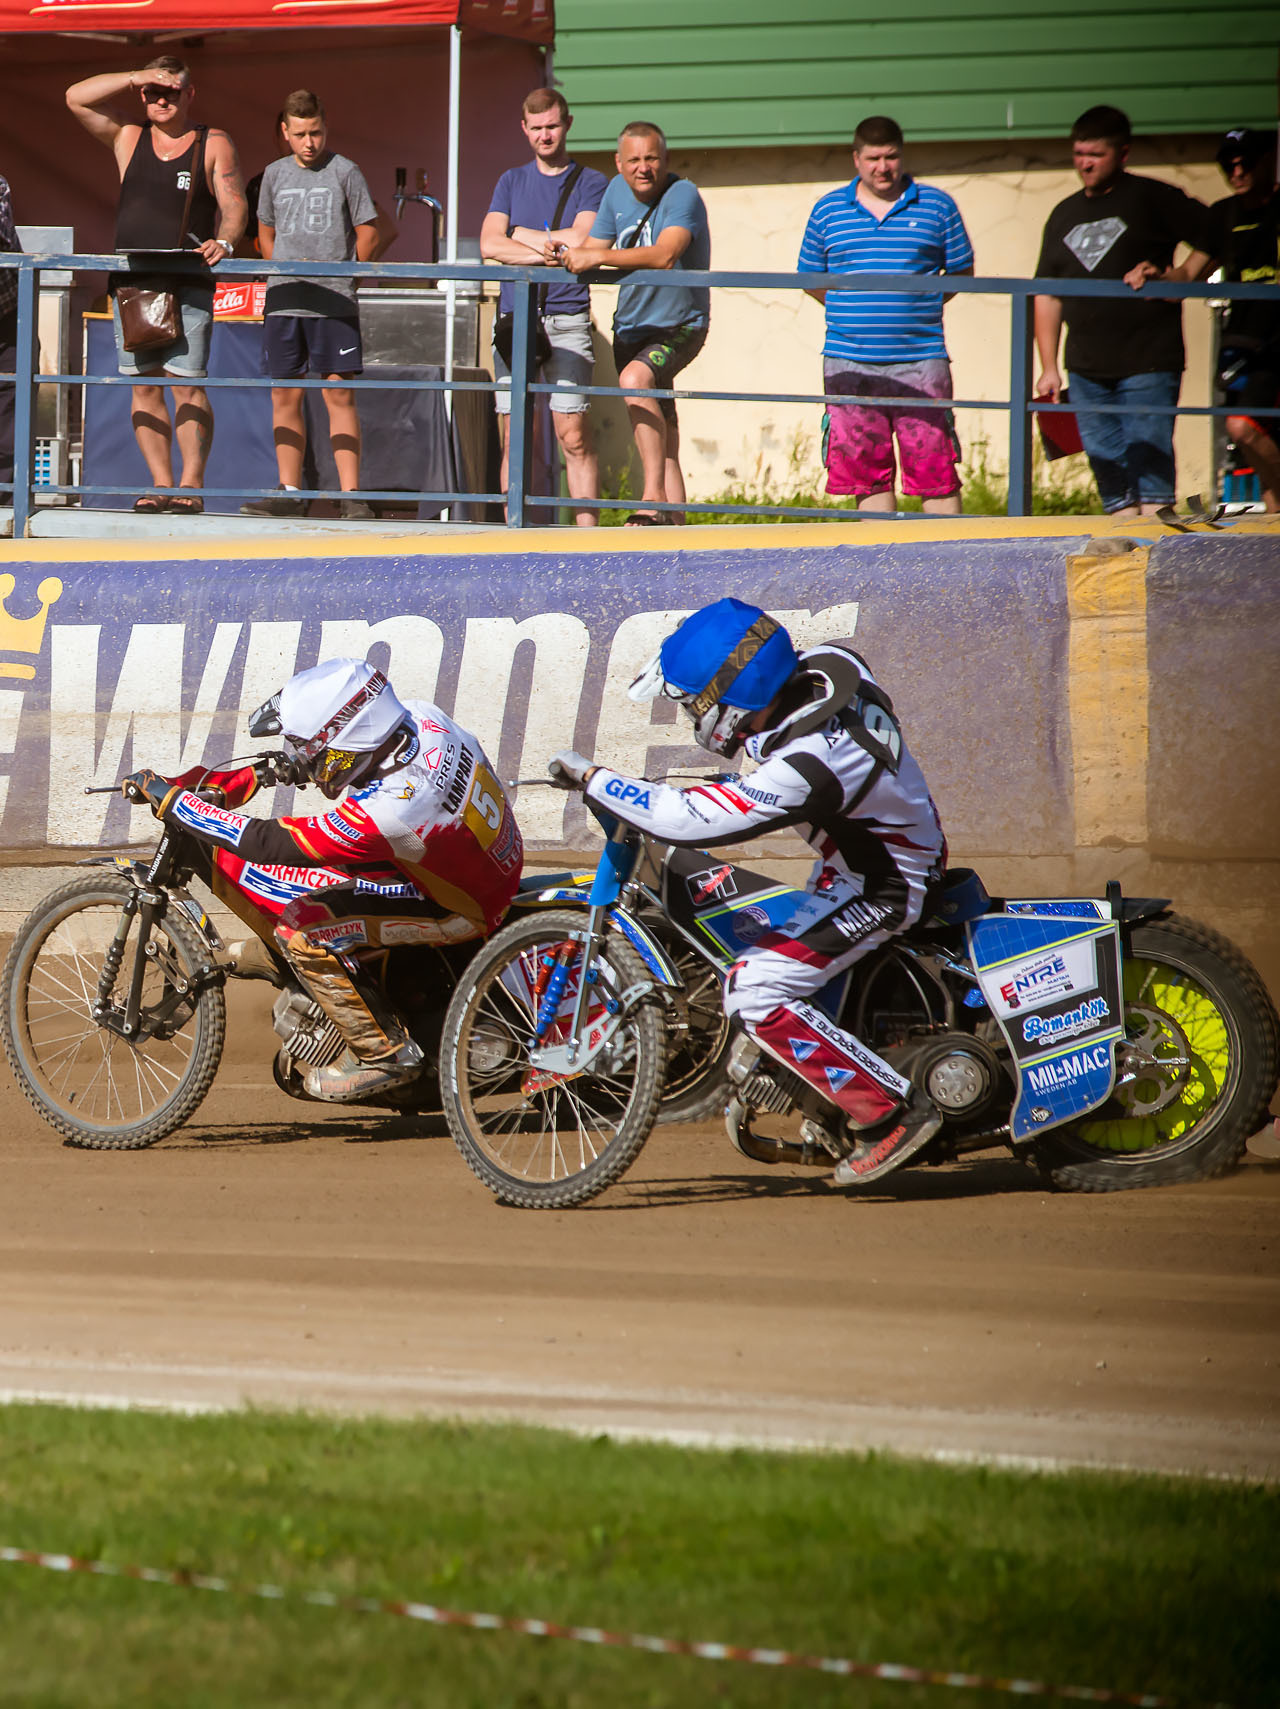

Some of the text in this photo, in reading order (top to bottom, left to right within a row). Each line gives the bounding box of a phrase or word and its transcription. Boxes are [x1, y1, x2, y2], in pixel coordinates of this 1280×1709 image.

[277, 187, 333, 236] 78
[436, 743, 455, 790] PRES
[441, 742, 475, 815] LAMPART
[181, 793, 248, 829] ABRAMCZYK
[470, 779, 501, 831] 5
[605, 778, 651, 810] GPA
[1024, 998, 1109, 1041] Bomankök
[1035, 1078, 1078, 1097] SWEDEN AB
